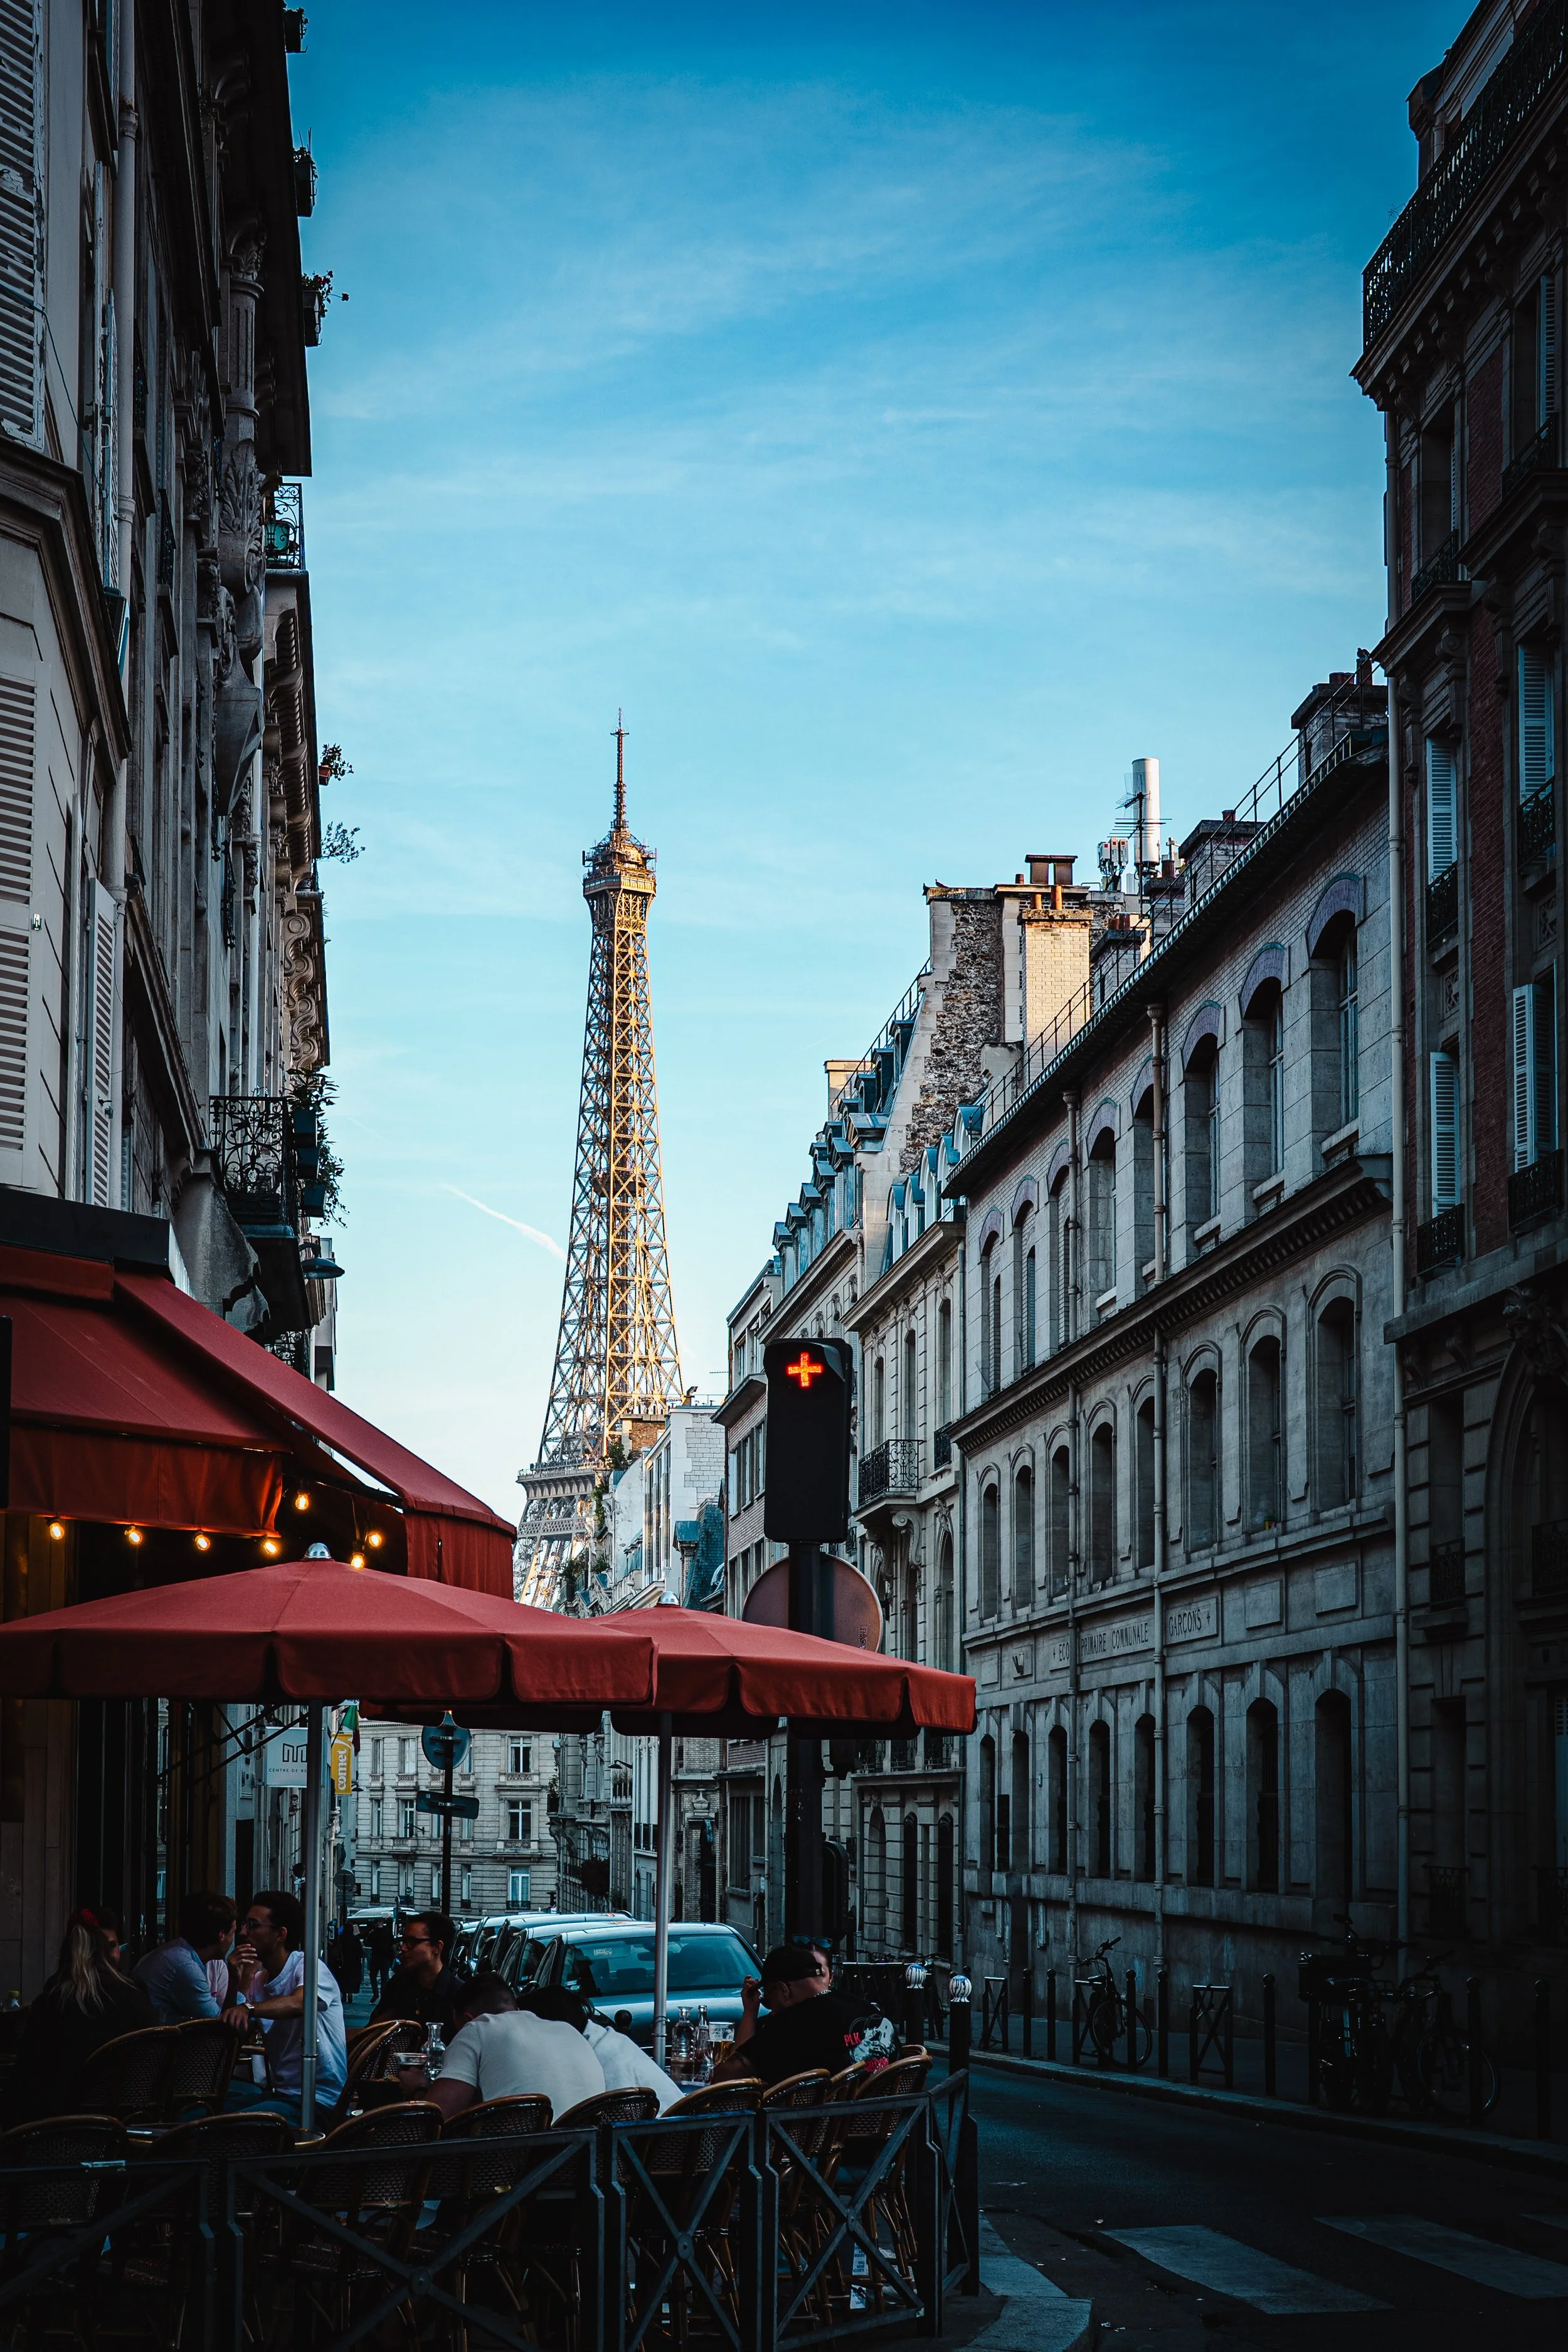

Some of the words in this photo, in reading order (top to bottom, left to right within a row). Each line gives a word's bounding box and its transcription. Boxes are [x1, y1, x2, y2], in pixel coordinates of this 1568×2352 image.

[1059, 1643, 1069, 1661] ECO
[1081, 1633, 1106, 1656] PRIMAIRE
[1112, 1623, 1148, 1649] COMMUNALE
[1168, 1609, 1202, 1638] GARÇONS
